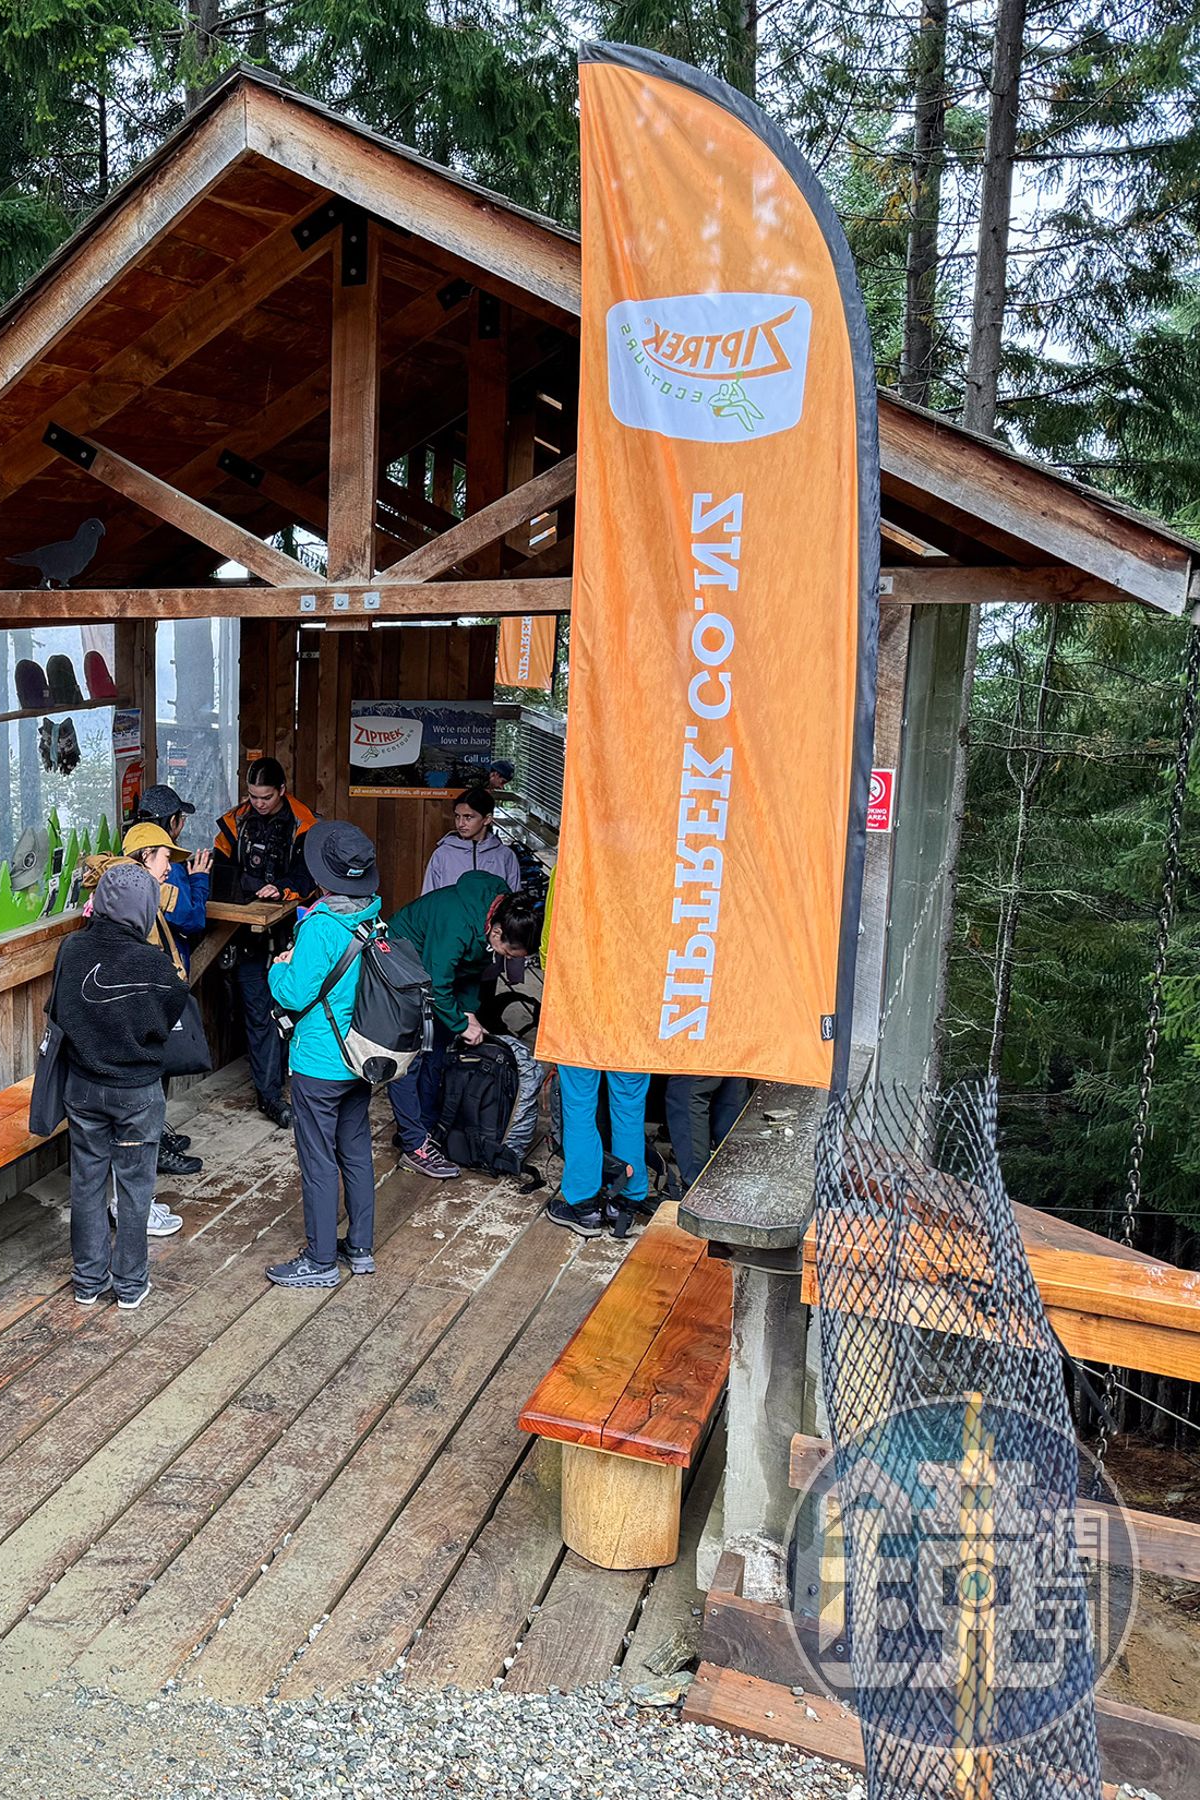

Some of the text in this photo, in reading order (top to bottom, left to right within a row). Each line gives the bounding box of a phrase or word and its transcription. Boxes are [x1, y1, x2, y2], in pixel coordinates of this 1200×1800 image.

[354, 723, 404, 746] ZIPTREK
[432, 725, 455, 733] We're
[472, 725, 491, 734] here
[440, 736, 458, 744] love
[470, 737, 490, 747] hang
[464, 755, 478, 763] Call
